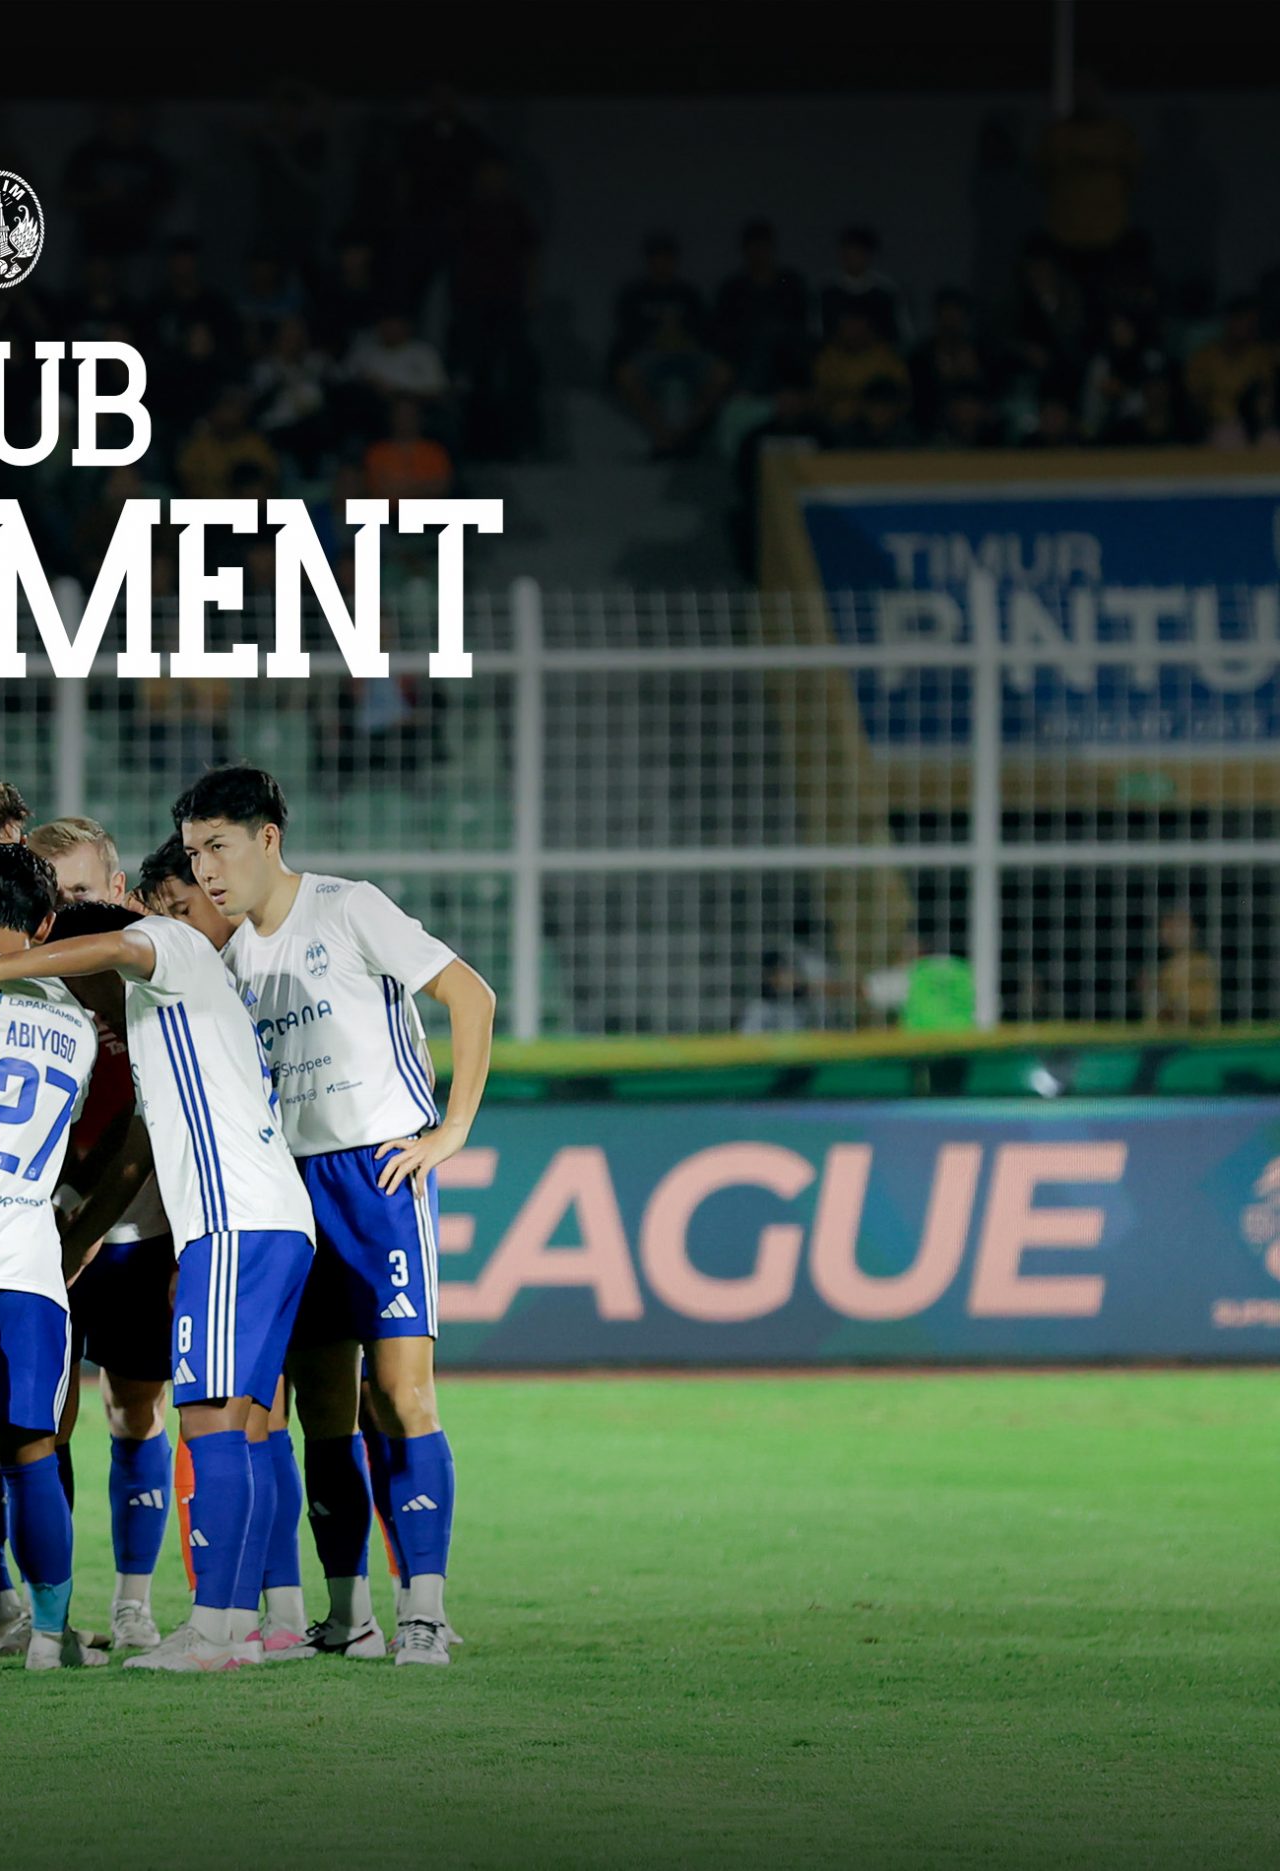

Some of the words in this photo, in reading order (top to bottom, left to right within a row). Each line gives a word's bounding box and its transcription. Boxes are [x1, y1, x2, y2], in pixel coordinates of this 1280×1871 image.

[883, 531, 1102, 584] TIMUR
[877, 586, 1280, 692] PNTU
[6, 1020, 77, 1064] ABIYOSO
[280, 1055, 332, 1079] Shopee
[388, 1249, 410, 1287] 3
[177, 1315, 194, 1353] 8
